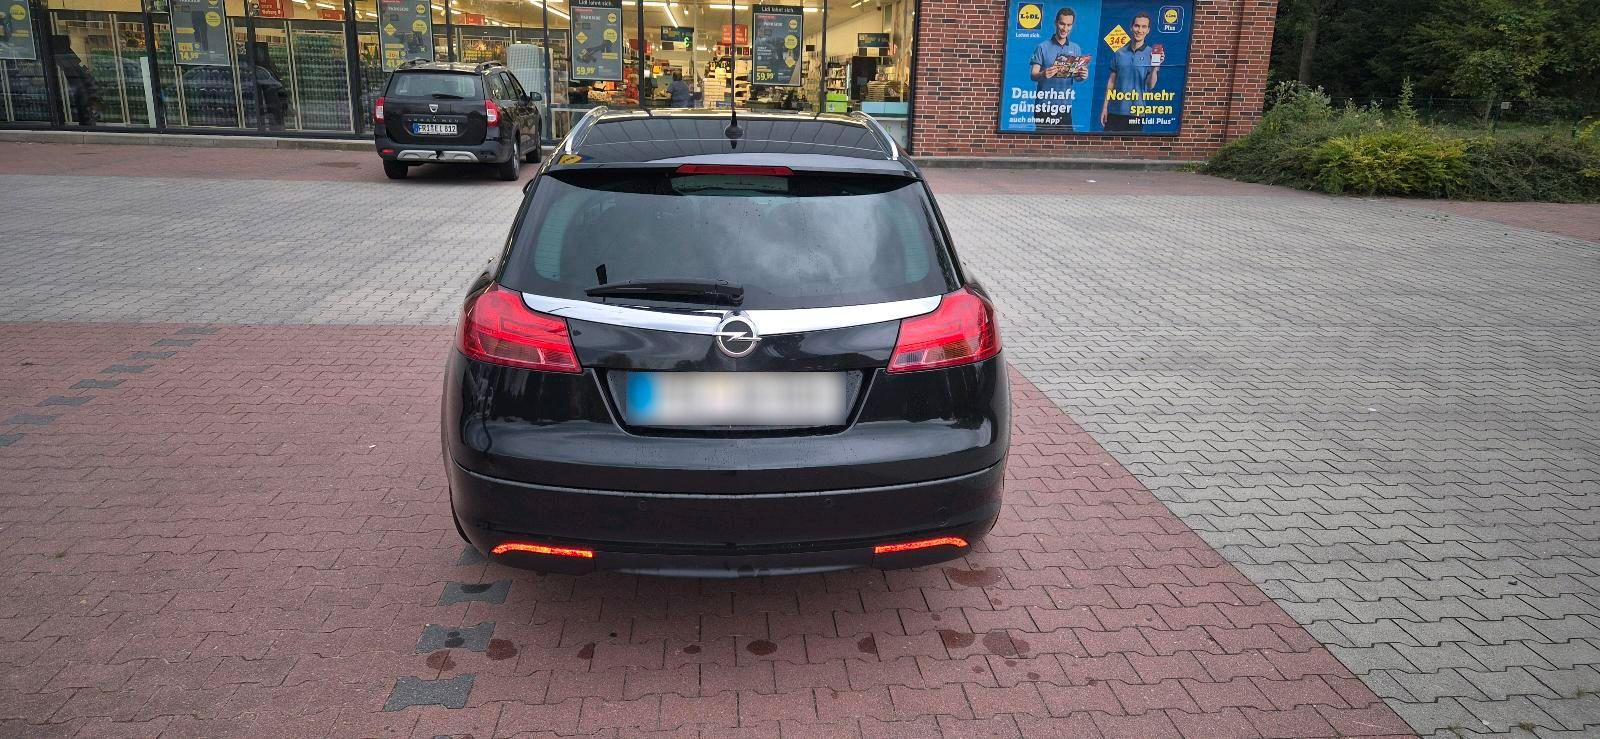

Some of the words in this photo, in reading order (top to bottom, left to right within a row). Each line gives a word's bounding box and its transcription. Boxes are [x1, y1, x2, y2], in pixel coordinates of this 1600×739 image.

[1012, 88, 1076, 99] Dauerhaft
[1107, 89, 1139, 100] Noch
[1143, 89, 1175, 100] mehr
[1010, 101, 1072, 115] günstiger
[1130, 105, 1172, 116] sparen
